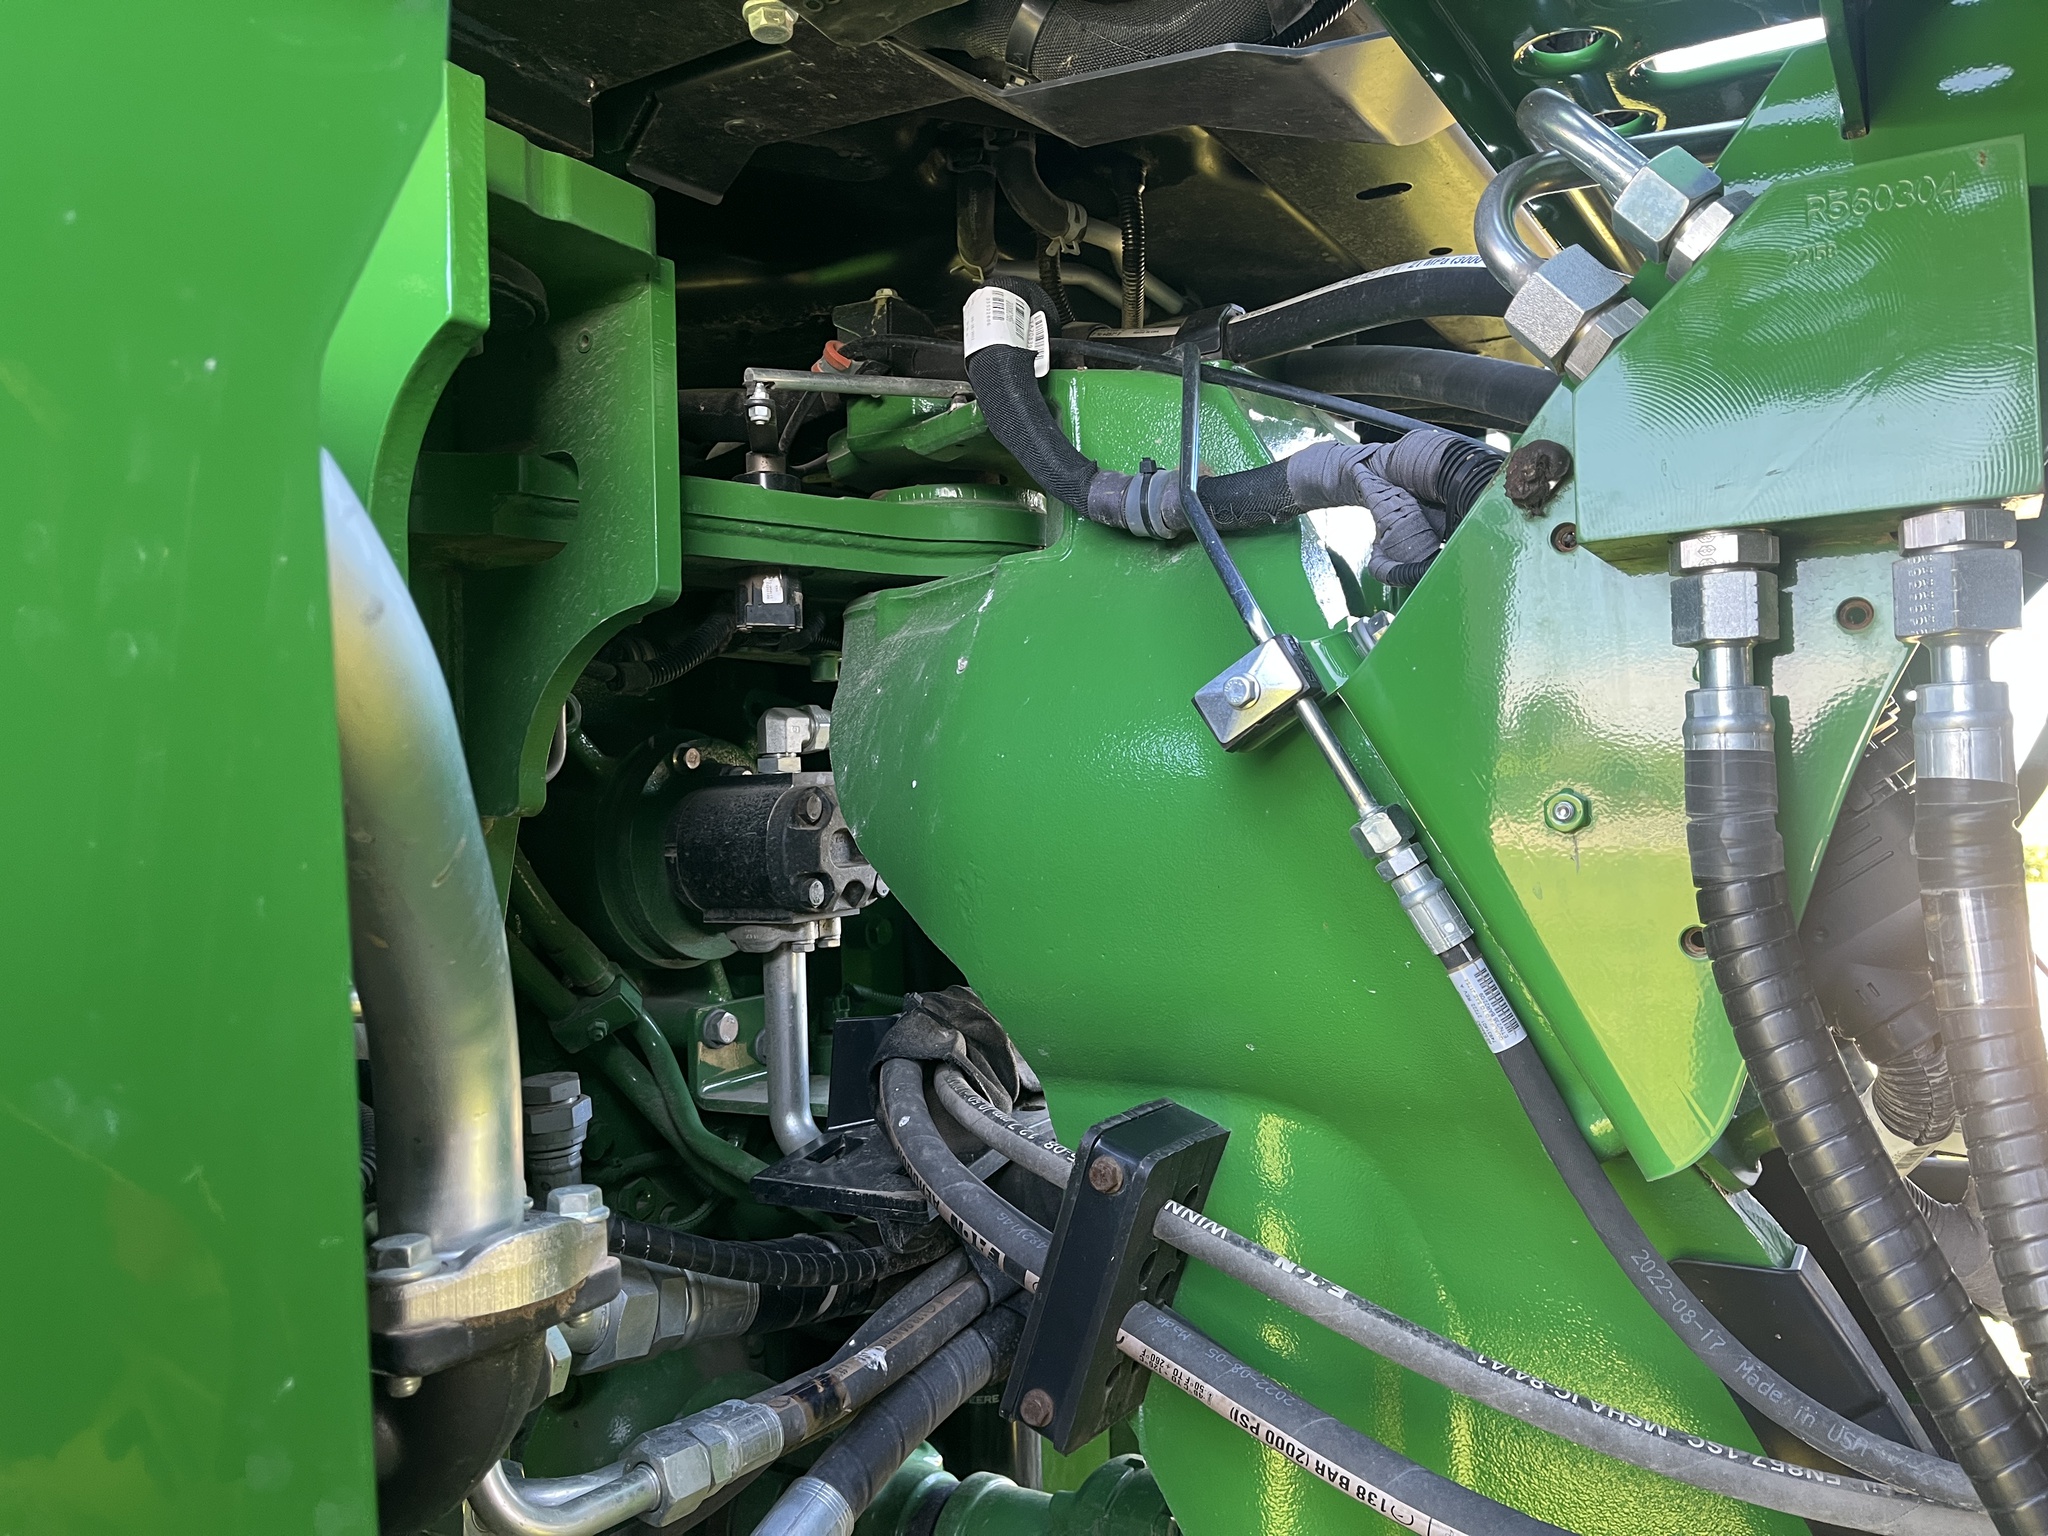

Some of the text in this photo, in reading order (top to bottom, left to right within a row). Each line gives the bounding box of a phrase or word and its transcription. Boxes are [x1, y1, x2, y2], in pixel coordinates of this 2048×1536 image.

[1806, 170, 1961, 229] R560304
[1155, 1313, 1192, 1342] Made
[1630, 1248, 1870, 1457] 2022-08-17 Made in USA
[1206, 1346, 1294, 1407] 2022-08-05
[968, 1394, 1000, 1405] EERE
[1589, 1399, 1668, 1438] MSHA
[1228, 1406, 1388, 1513] 138 BAR (2000 PSI)
[1686, 1430, 1740, 1459] 1SC
[1753, 1455, 1841, 1486] EN857
